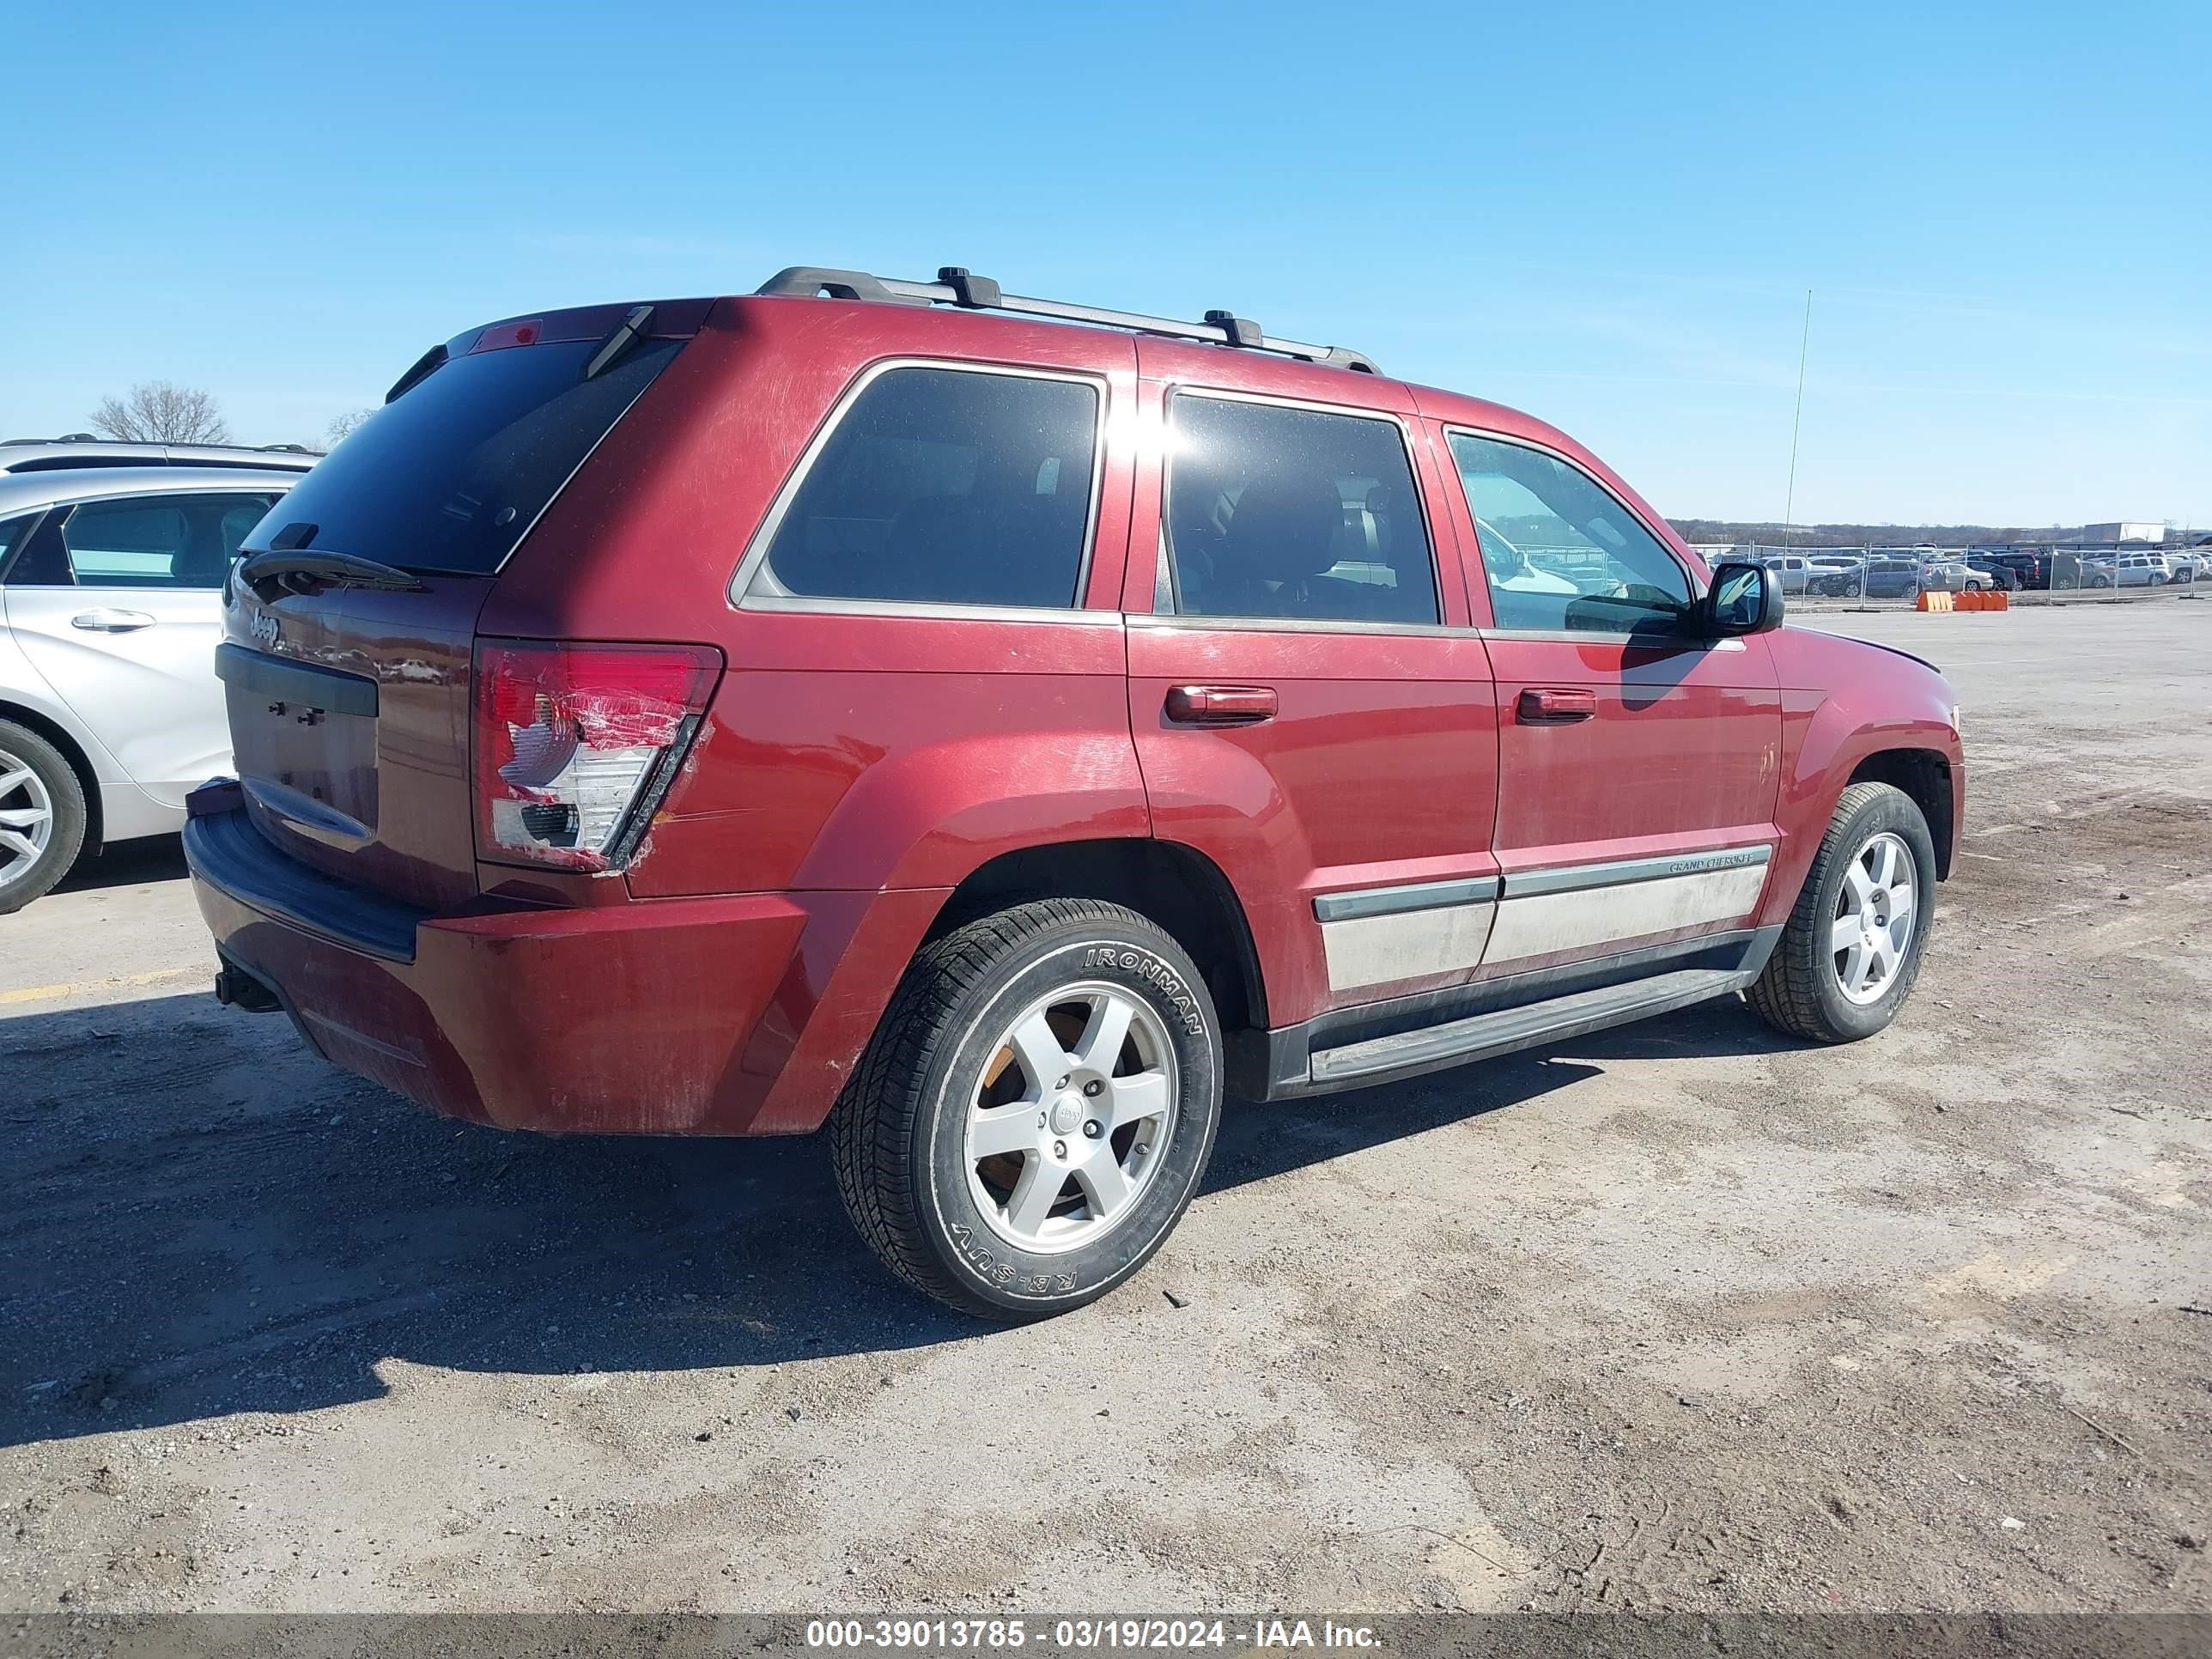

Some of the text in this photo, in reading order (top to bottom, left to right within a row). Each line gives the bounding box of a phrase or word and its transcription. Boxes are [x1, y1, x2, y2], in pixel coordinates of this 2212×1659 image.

[251, 607, 279, 647] Jeep
[1669, 853, 1753, 872] GRAND CHEROKEE
[1084, 947, 1203, 1036] IRONMAN
[951, 1223, 1077, 1292] RB-SUV
